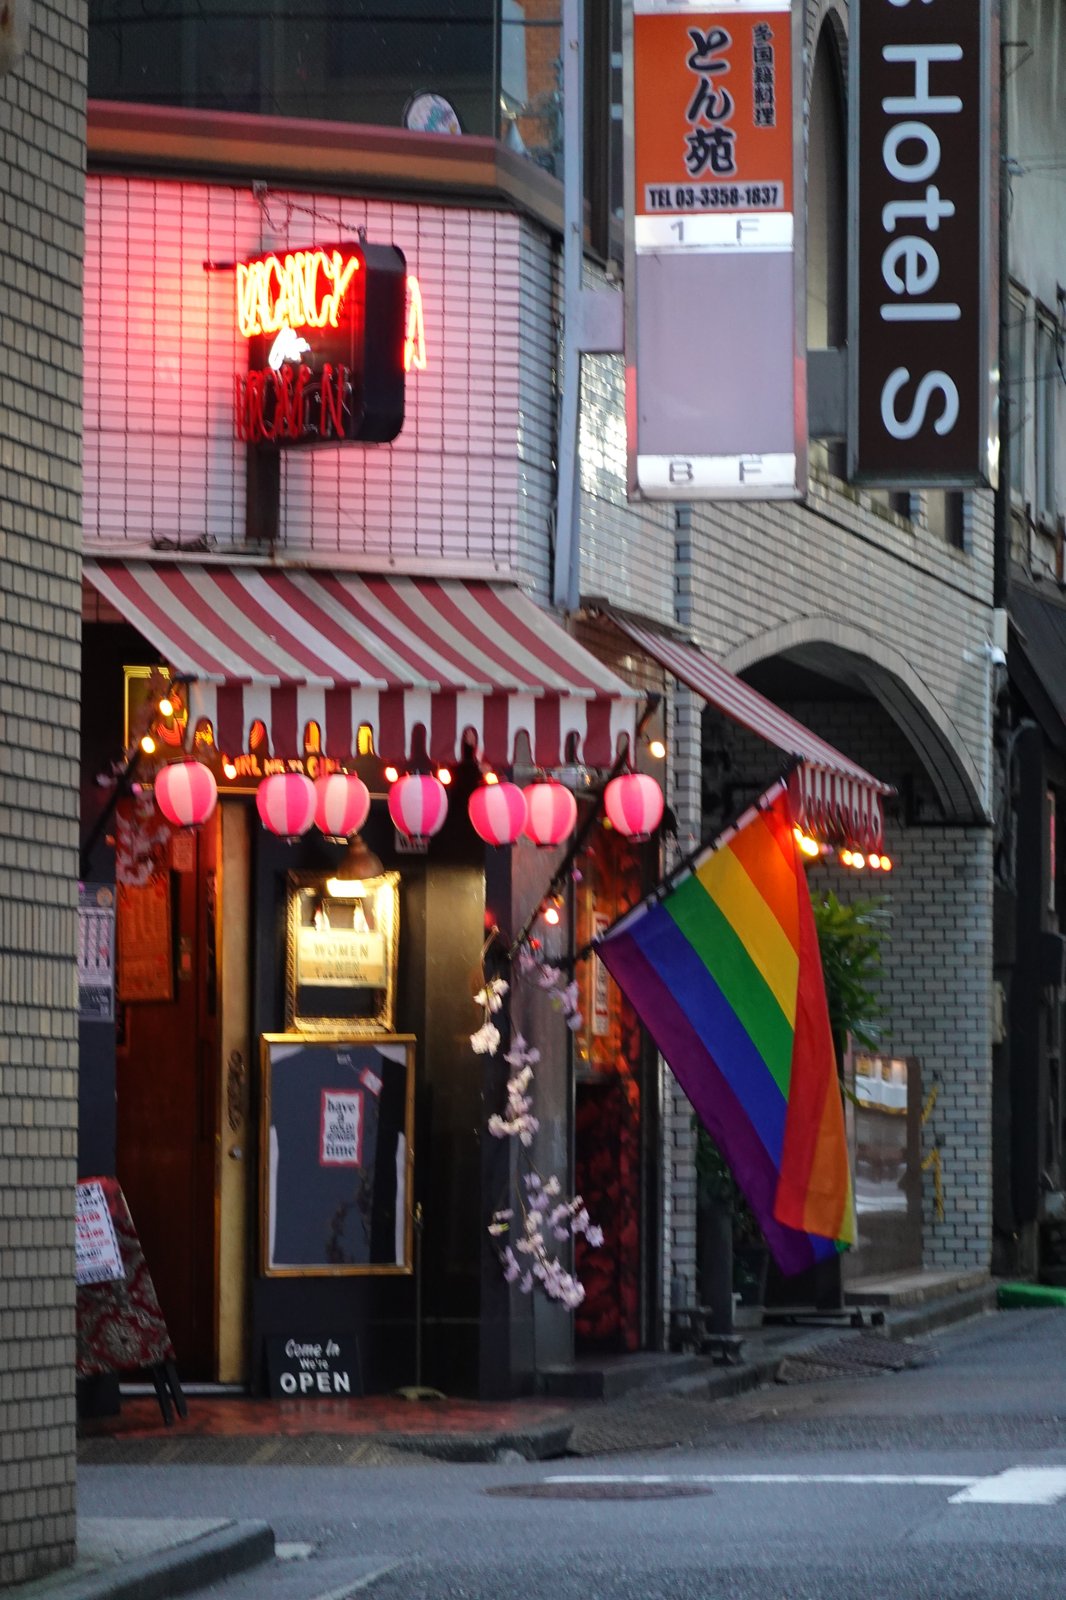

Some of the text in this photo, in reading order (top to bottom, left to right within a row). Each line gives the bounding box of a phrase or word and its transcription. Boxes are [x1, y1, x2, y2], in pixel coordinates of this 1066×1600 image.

[684, 26, 738, 178] とん苑
[648, 185, 779, 209] TEL 03-3358-1837
[880, 43, 964, 321] Hotel
[236, 250, 359, 336] VACANCY
[880, 366, 961, 441] S
[280, 1371, 350, 1393] OPEN
[286, 1338, 321, 1357] Come
